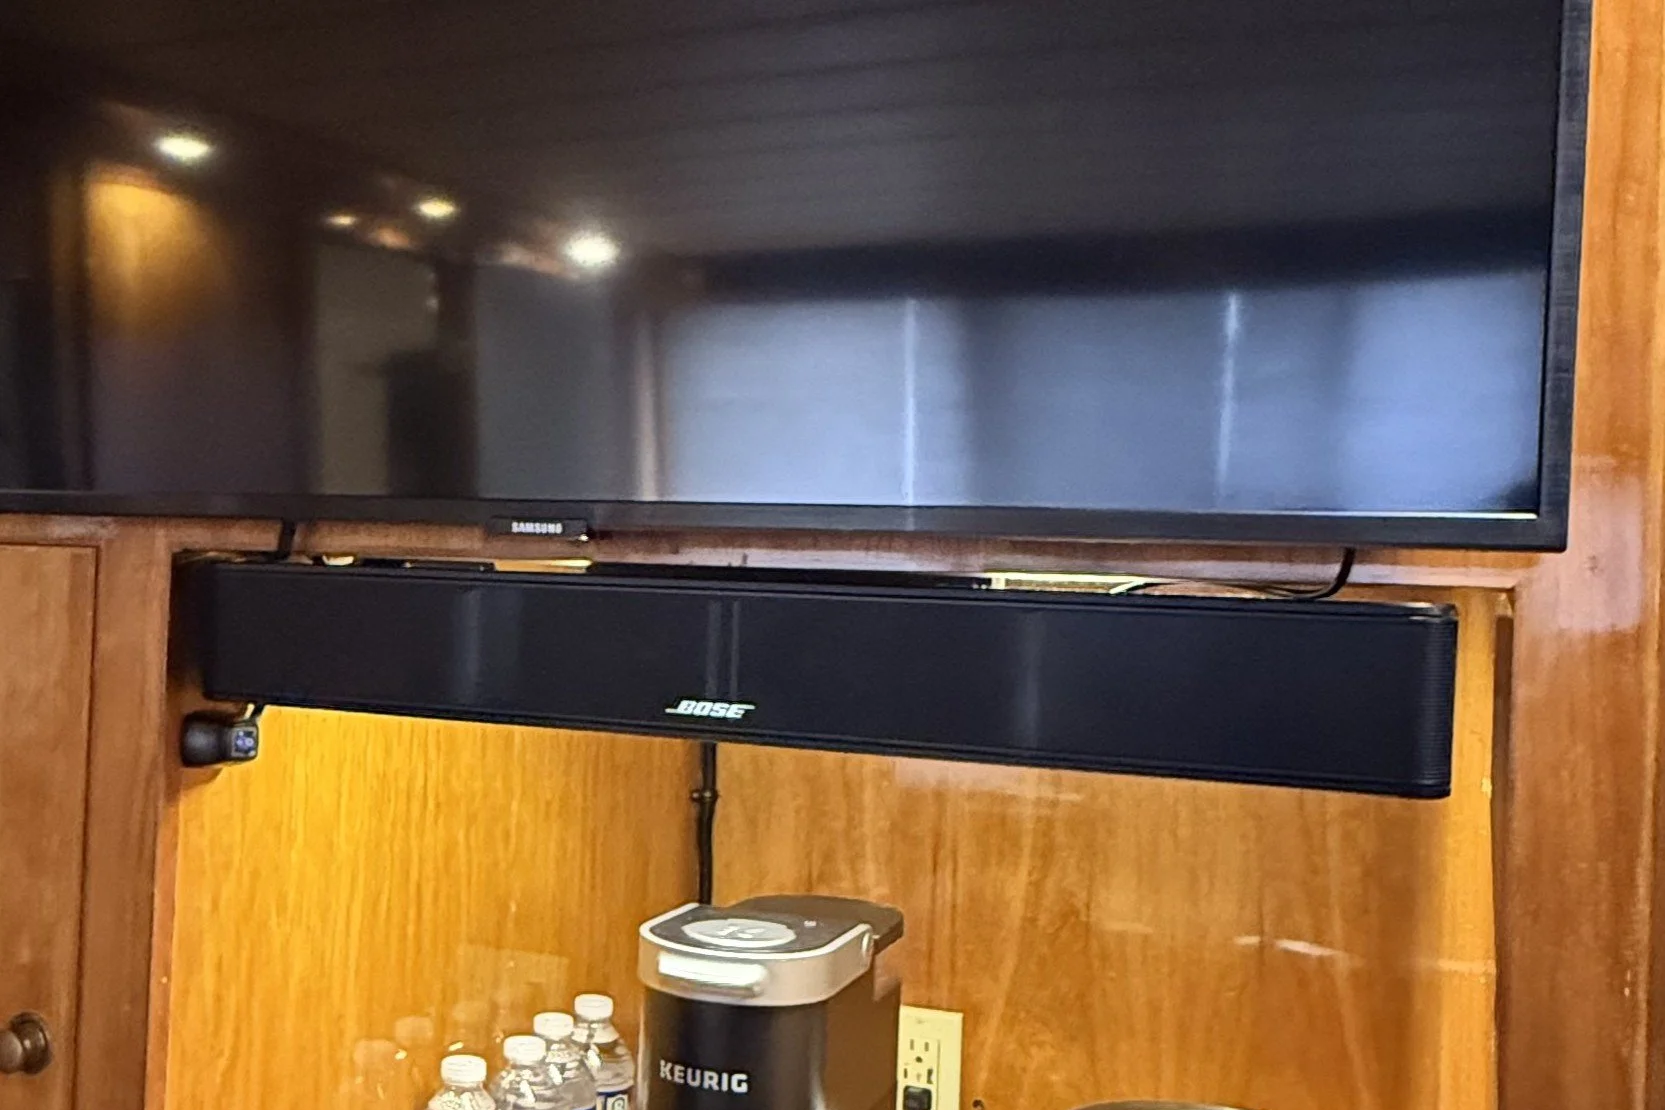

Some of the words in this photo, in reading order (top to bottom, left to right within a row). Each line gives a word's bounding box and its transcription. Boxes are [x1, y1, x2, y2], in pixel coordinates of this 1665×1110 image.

[511, 521, 563, 534] SAMSUNG
[665, 699, 755, 719] BOSE
[659, 1059, 748, 1093] KEURIG
